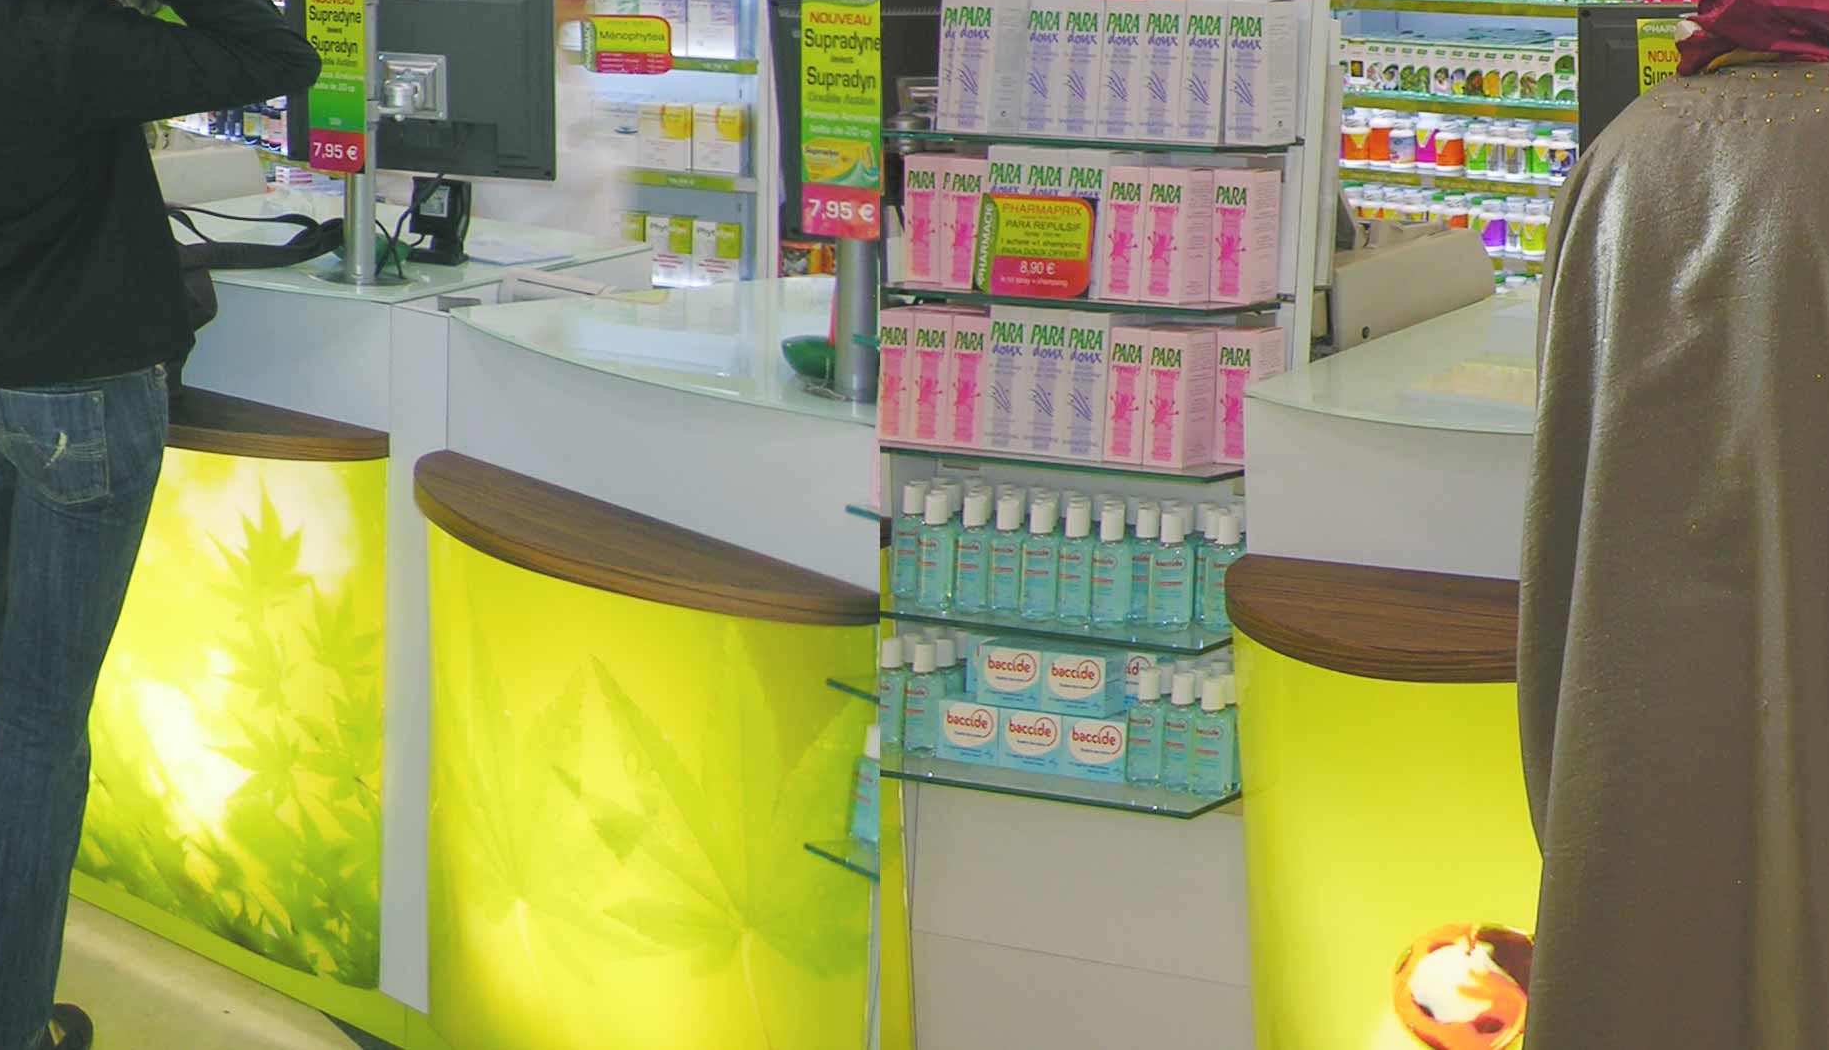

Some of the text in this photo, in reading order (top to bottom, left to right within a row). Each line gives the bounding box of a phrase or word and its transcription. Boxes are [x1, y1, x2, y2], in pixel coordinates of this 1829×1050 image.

[308, 5, 362, 27] Supradyne
[810, 12, 872, 27] NOUVEAU
[959, 6, 993, 28] PARA
[1229, 15, 1263, 38] PARA
[311, 35, 359, 55] Supradyn
[804, 27, 880, 53] Supradyne
[807, 66, 877, 92] Supradyn
[314, 141, 359, 160] 7,95 €
[1149, 183, 1183, 204] PARA
[808, 198, 875, 224] 7,95 €
[1001, 202, 1082, 217] PHARMAPRIX
[1005, 220, 1032, 231] PARA
[1019, 260, 1056, 276] 8,90 €
[987, 654, 1031, 673] baccide
[1072, 728, 1116, 747] baccide
